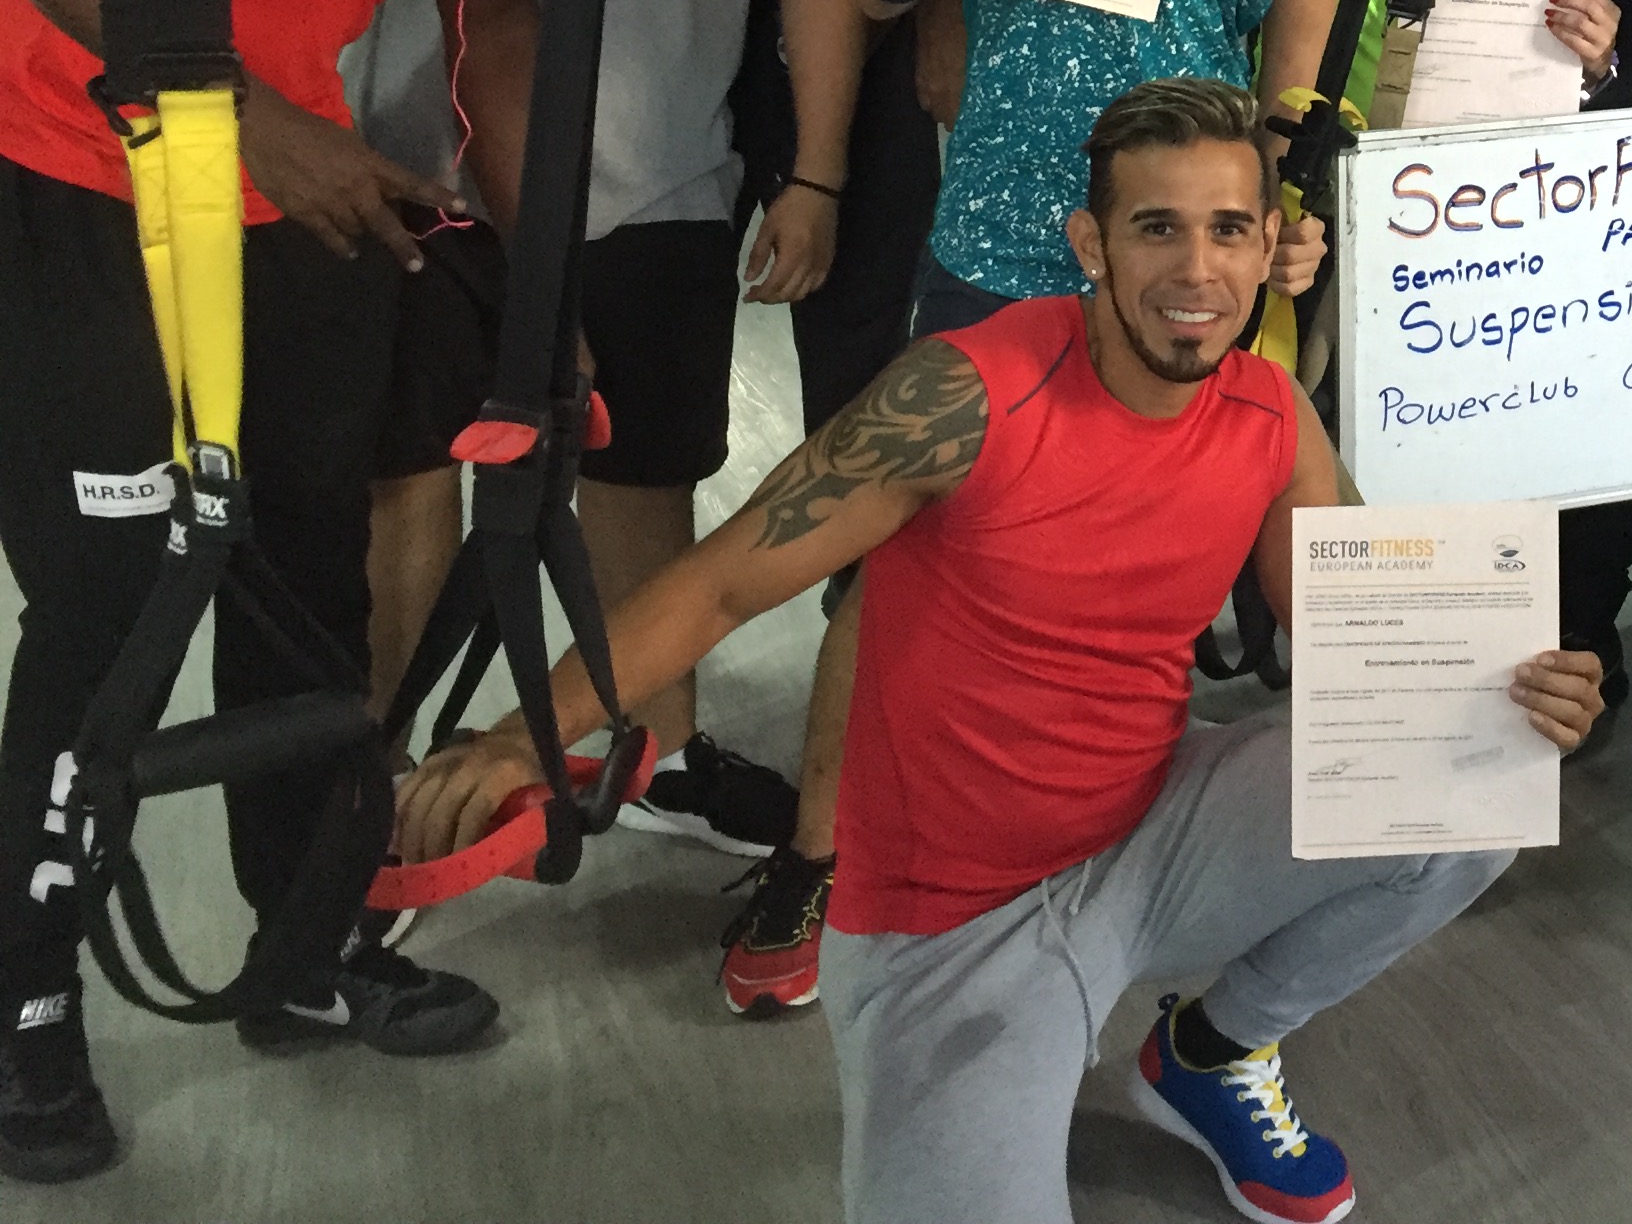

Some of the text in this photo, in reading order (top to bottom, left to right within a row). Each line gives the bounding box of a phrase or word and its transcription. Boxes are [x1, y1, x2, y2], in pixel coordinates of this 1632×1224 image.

[83, 482, 160, 501] H.R.S.D.
[1309, 540, 1434, 559] SECTORFITNESS
[1310, 559, 1434, 572] EUROPEAN ACADEMY
[20, 992, 68, 1023] NIKE
